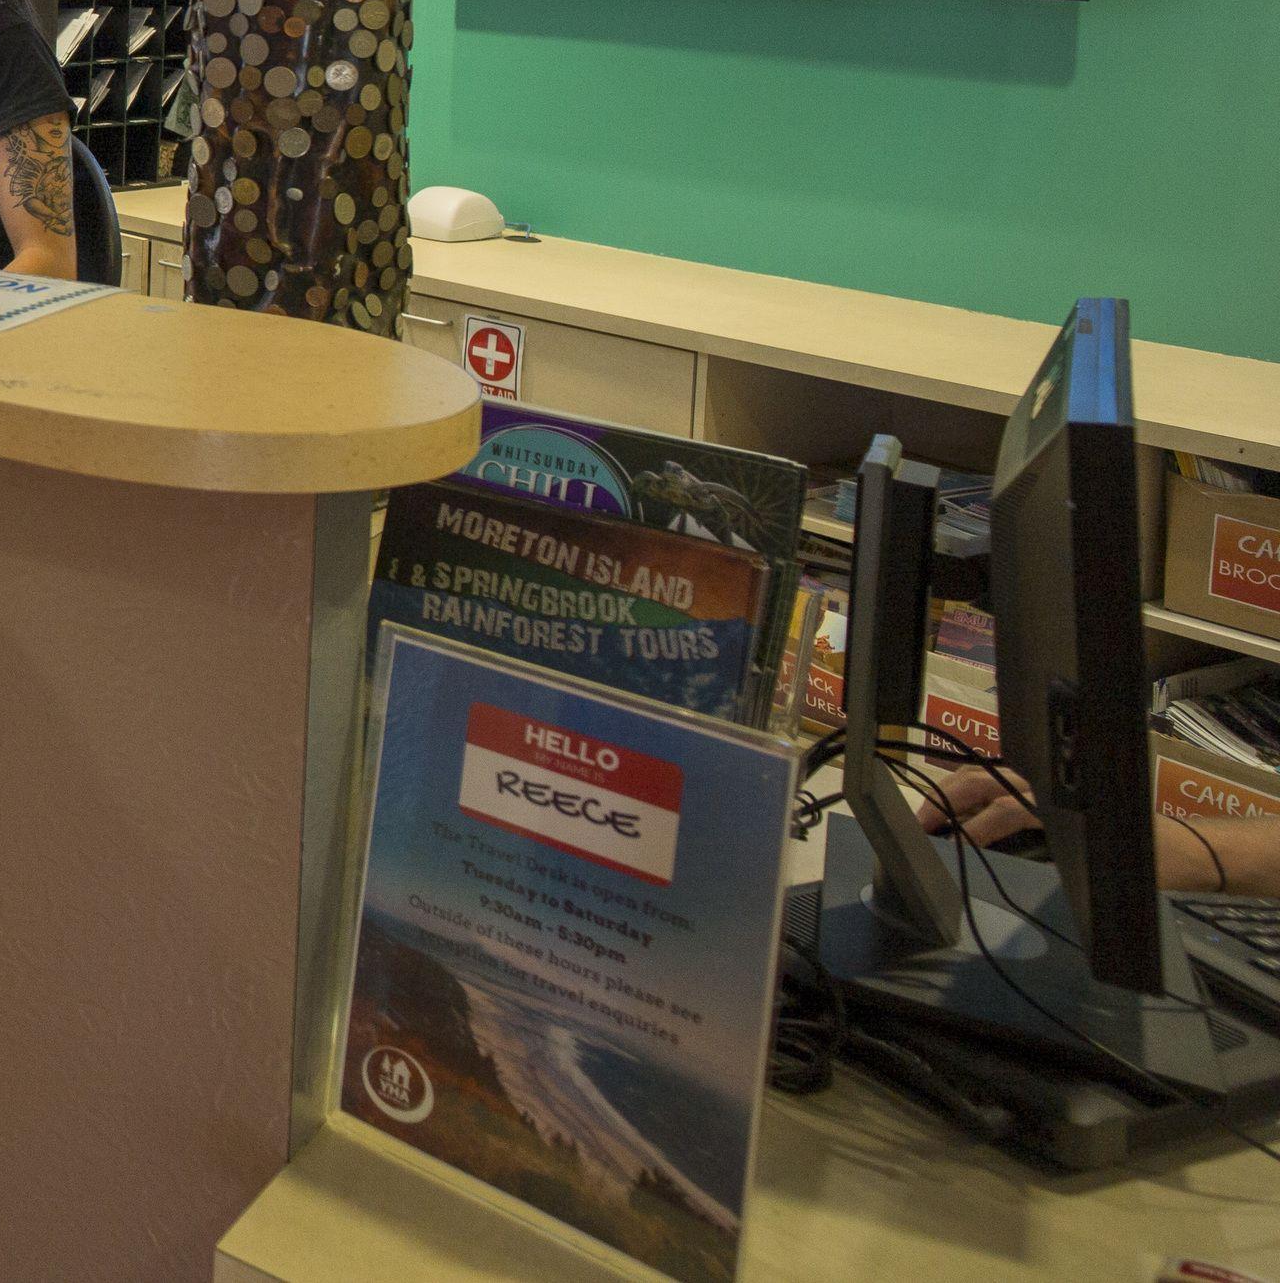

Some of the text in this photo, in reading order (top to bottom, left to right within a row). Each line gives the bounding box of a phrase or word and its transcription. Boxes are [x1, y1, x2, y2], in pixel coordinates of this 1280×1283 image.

[492, 442, 599, 478] WHITSUNDAY
[435, 501, 695, 611] MORETON ISLAND
[410, 561, 638, 625] & SPRINGBROOK
[421, 592, 721, 661] RAINFOREST TOURS
[523, 723, 620, 771] HELLO
[495, 771, 643, 839] REECE
[461, 859, 654, 949] Tuesday to Saturday
[468, 833, 523, 866] Travel
[525, 854, 568, 885] Desk
[572, 873, 588, 892] is
[591, 882, 638, 914] open
[407, 893, 704, 1024] Outside of these hours please see
[556, 924, 627, 964] 5:30pm
[531, 970, 585, 1006] travel
